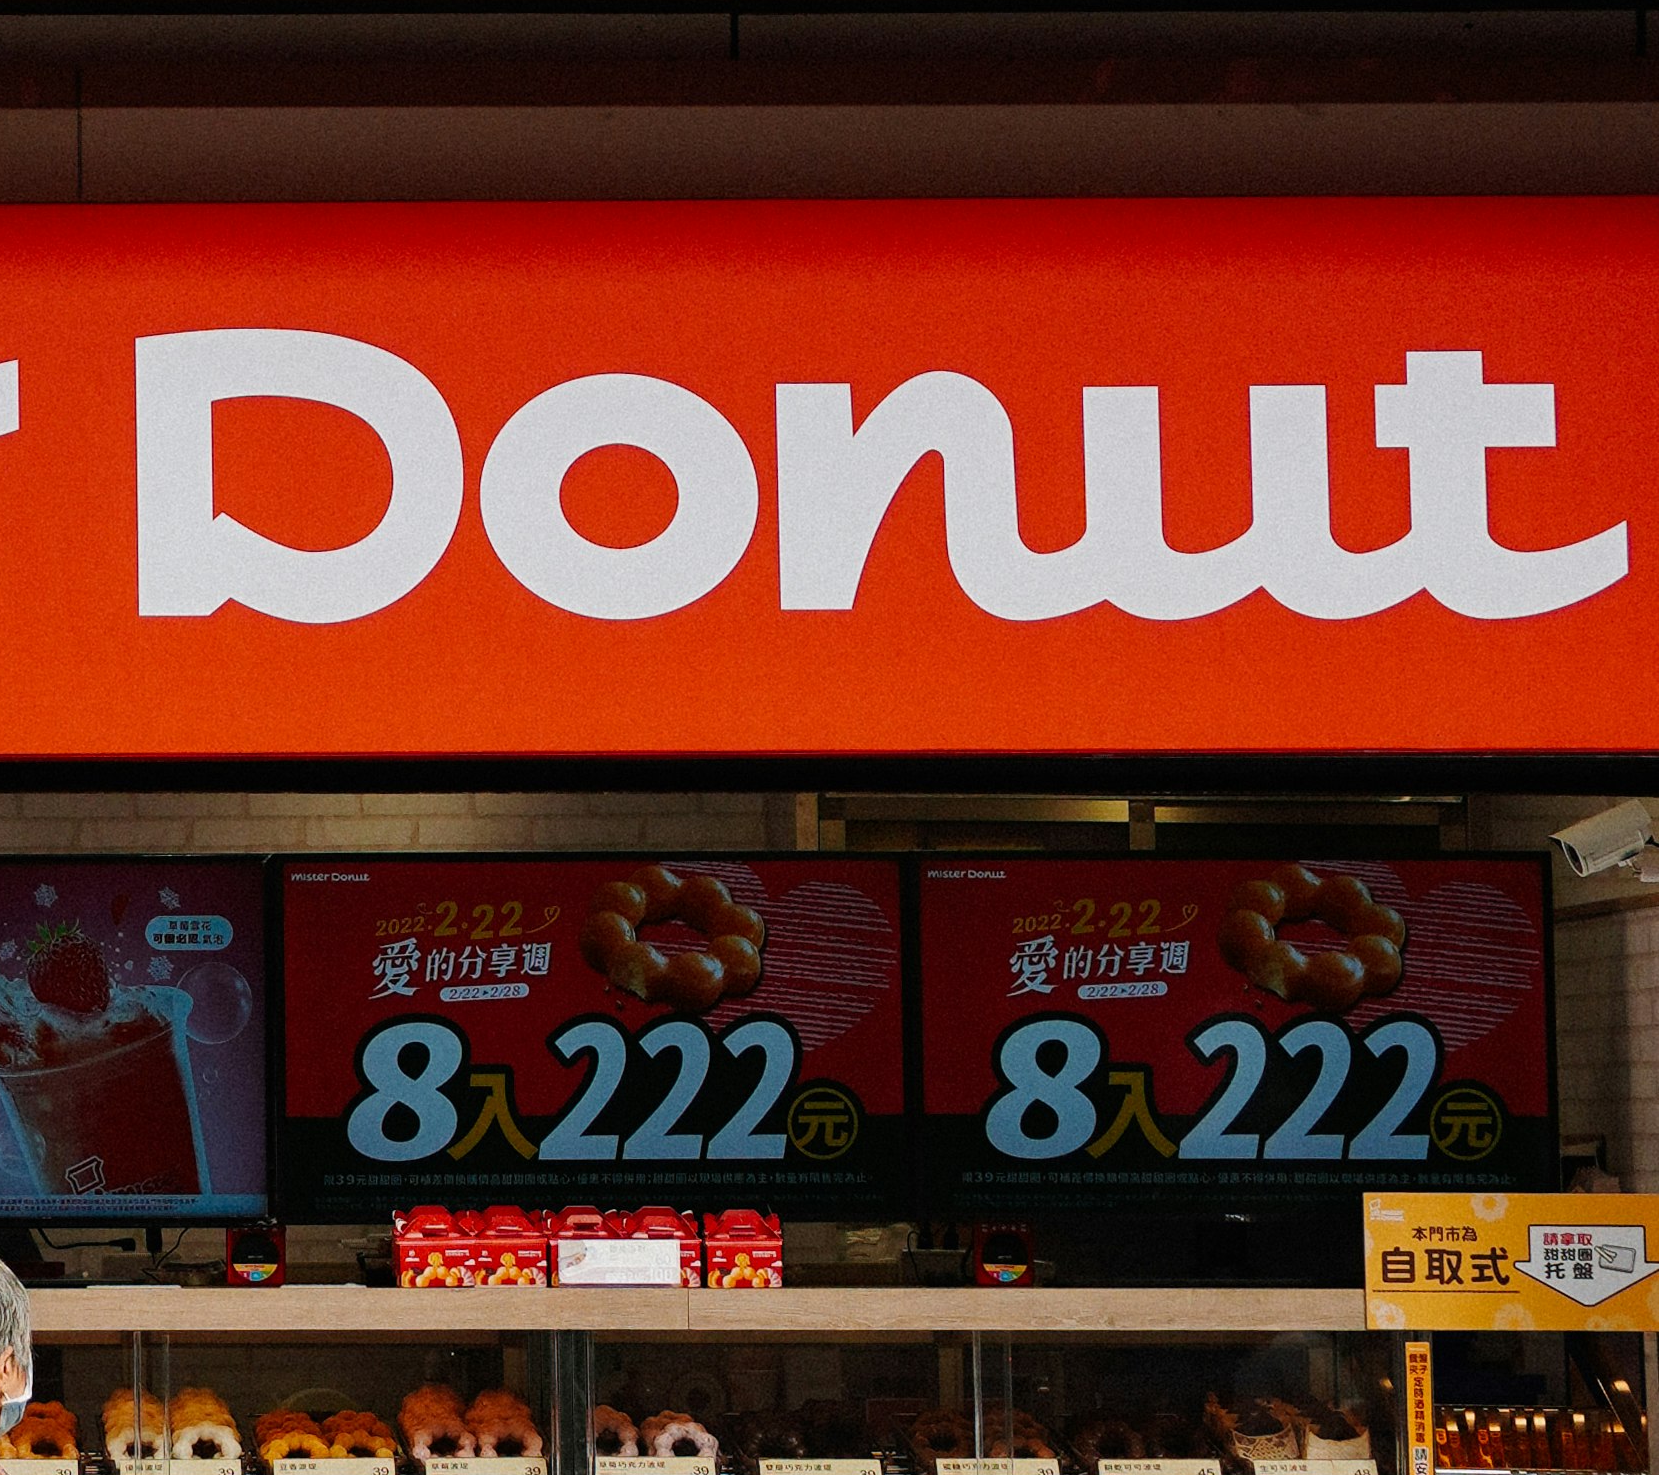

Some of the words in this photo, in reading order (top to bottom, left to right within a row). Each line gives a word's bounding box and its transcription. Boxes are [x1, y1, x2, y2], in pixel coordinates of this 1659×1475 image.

[135, 328, 1628, 626] Donut
[368, 936, 552, 1000] 愛的分享週
[1005, 934, 1191, 998] 愛的分享週
[490, 985, 521, 997] 2/28
[1128, 984, 1159, 996] 2/28
[1412, 1227, 1478, 1242] 本門市為
[1543, 1233, 1592, 1246] 請拿取
[1381, 1247, 1510, 1285] 自取式
[1545, 1263, 1594, 1280] 托盤
[525, 1467, 541, 1475] 39
[693, 1466, 709, 1475] 39
